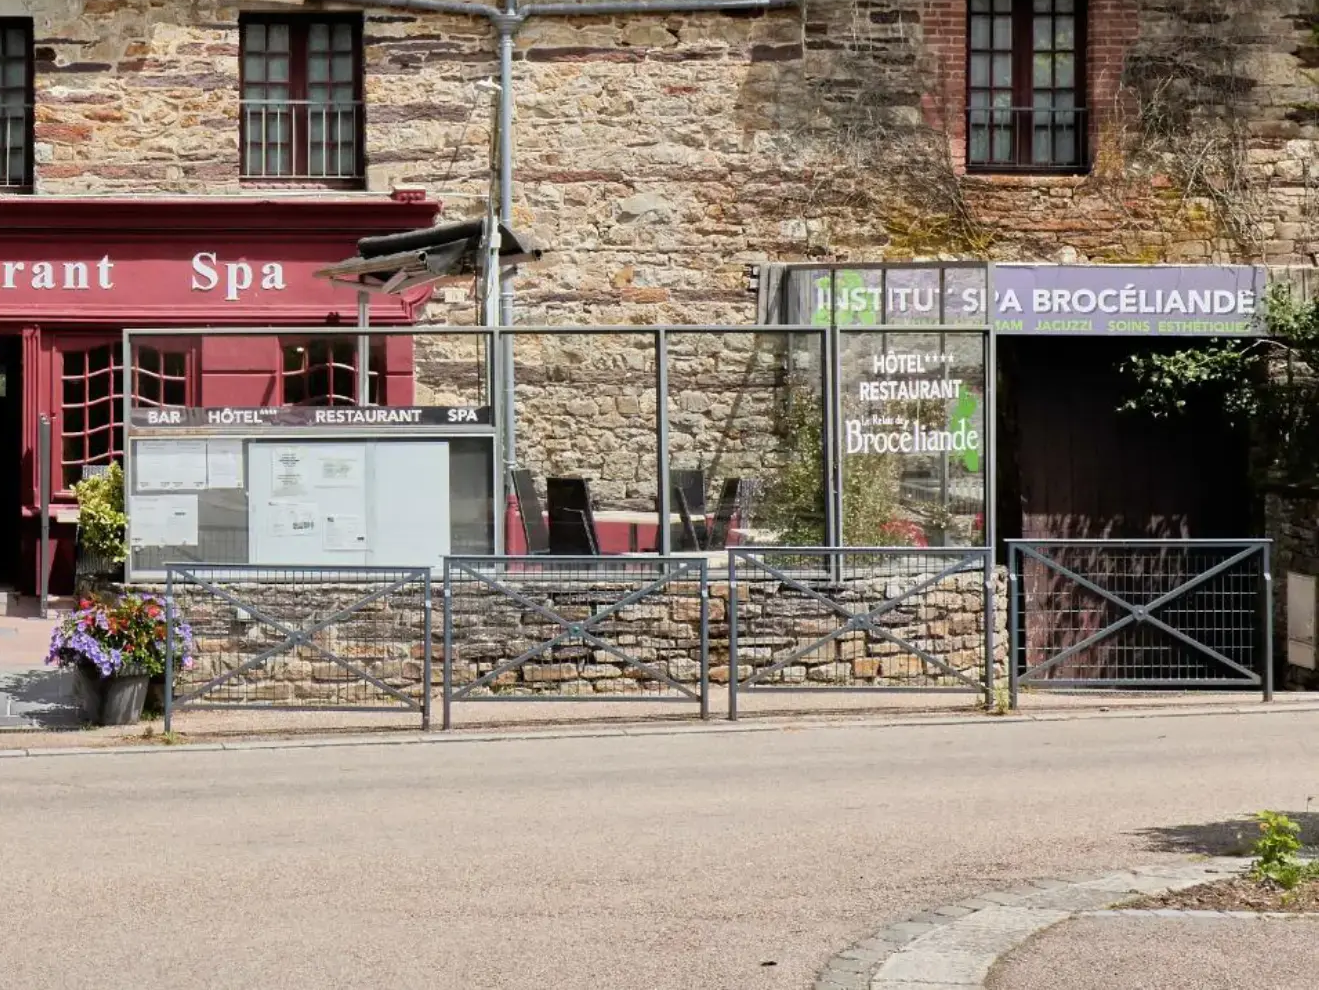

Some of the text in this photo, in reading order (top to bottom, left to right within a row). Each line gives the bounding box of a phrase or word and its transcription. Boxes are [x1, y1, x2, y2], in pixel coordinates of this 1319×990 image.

[191, 253, 286, 301] Spa
[1033, 284, 1256, 314] BROCÉLIANDE
[1036, 320, 1092, 331] JACUZZI
[1107, 321, 1150, 332] SOINS
[873, 351, 926, 374] HÔTEL
[860, 380, 962, 401] RESTAURANT
[148, 409, 479, 424] BAR HÔTEL RESTAURANT SPA
[845, 418, 979, 454] Brocéliande
